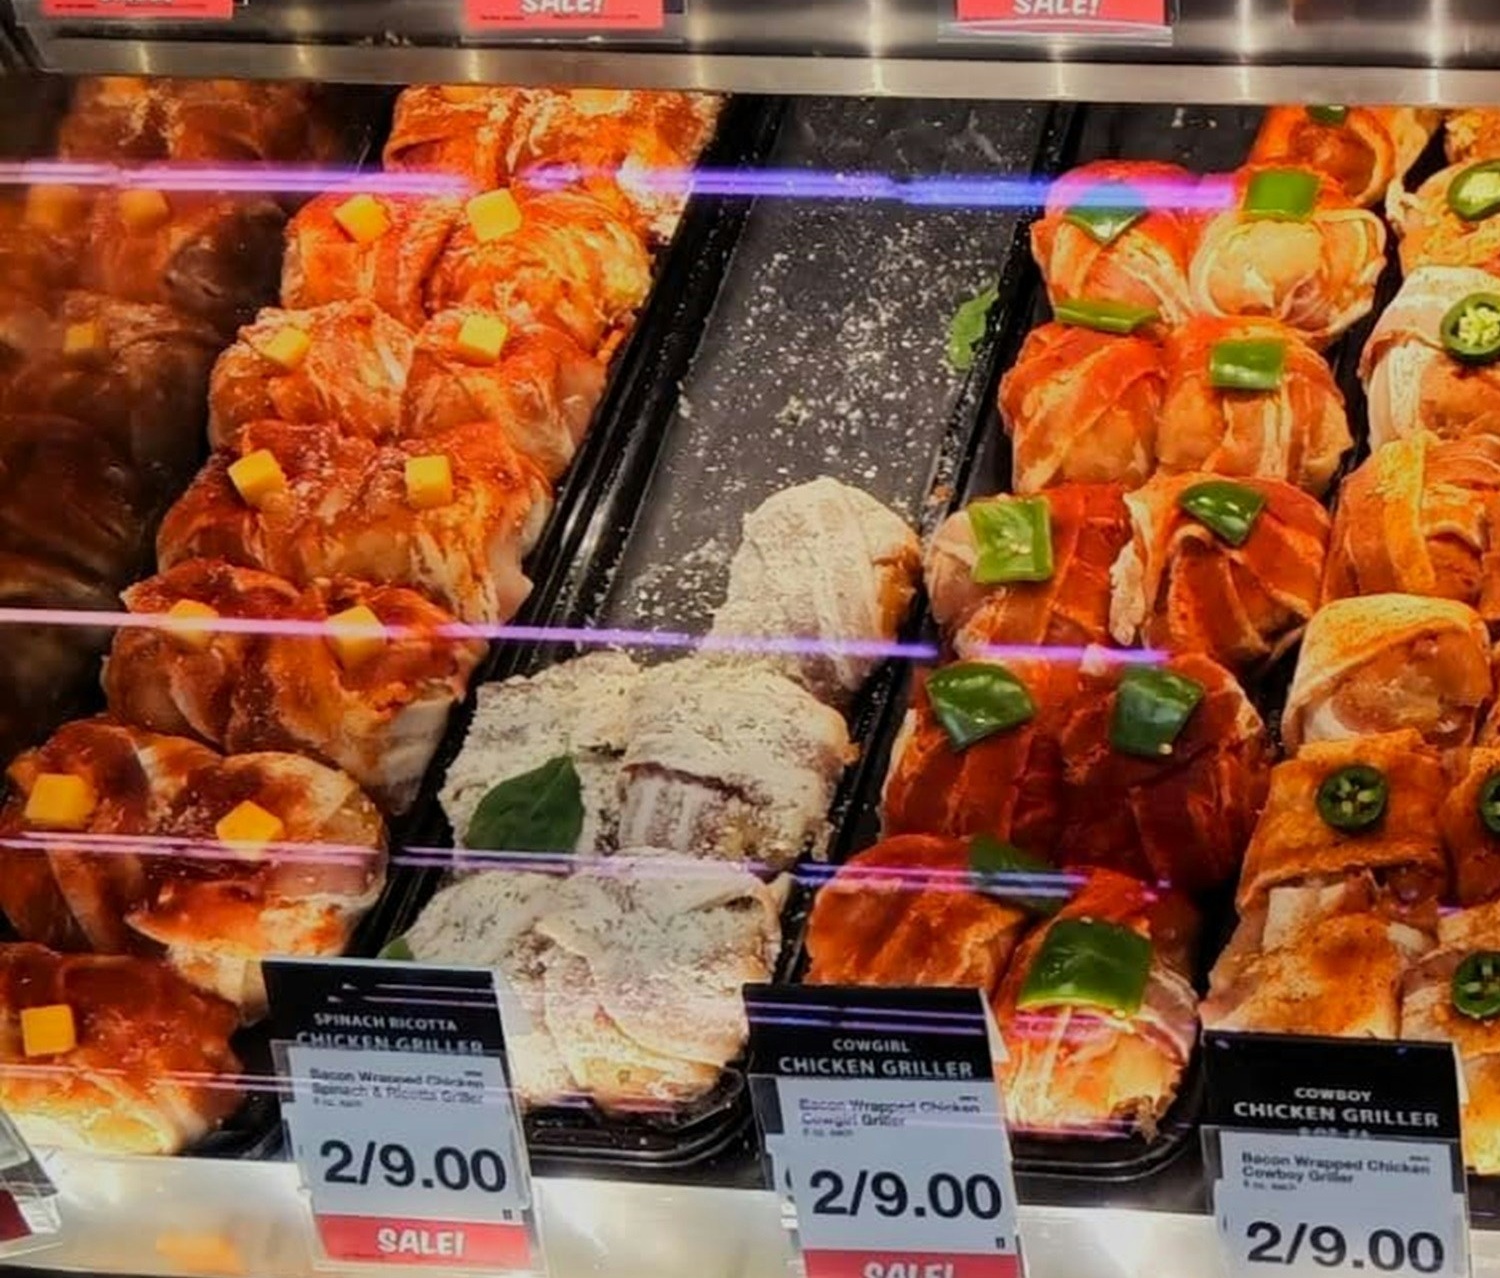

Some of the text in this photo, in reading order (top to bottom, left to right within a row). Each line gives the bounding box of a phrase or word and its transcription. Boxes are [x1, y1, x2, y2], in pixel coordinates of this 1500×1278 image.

[314, 1013, 458, 1031] SPINACH RICOTTA
[296, 1032, 484, 1053] CHICKEN GRILLER
[833, 1039, 910, 1052] COWGIRL
[779, 1056, 973, 1078] CHICKEN GRILLER
[1294, 1087, 1372, 1102] COWBOY
[1234, 1102, 1440, 1127] CHICKEN GRILLER
[320, 1139, 506, 1193] 2/9.00
[1242, 1152, 1430, 1176] Bacon Wrapped Chicken
[1242, 1167, 1353, 1183] Cowboy Griller
[809, 1169, 1001, 1220] 2/9.00
[377, 1228, 464, 1255] SALE!
[1247, 1221, 1444, 1273] 2/9.00
